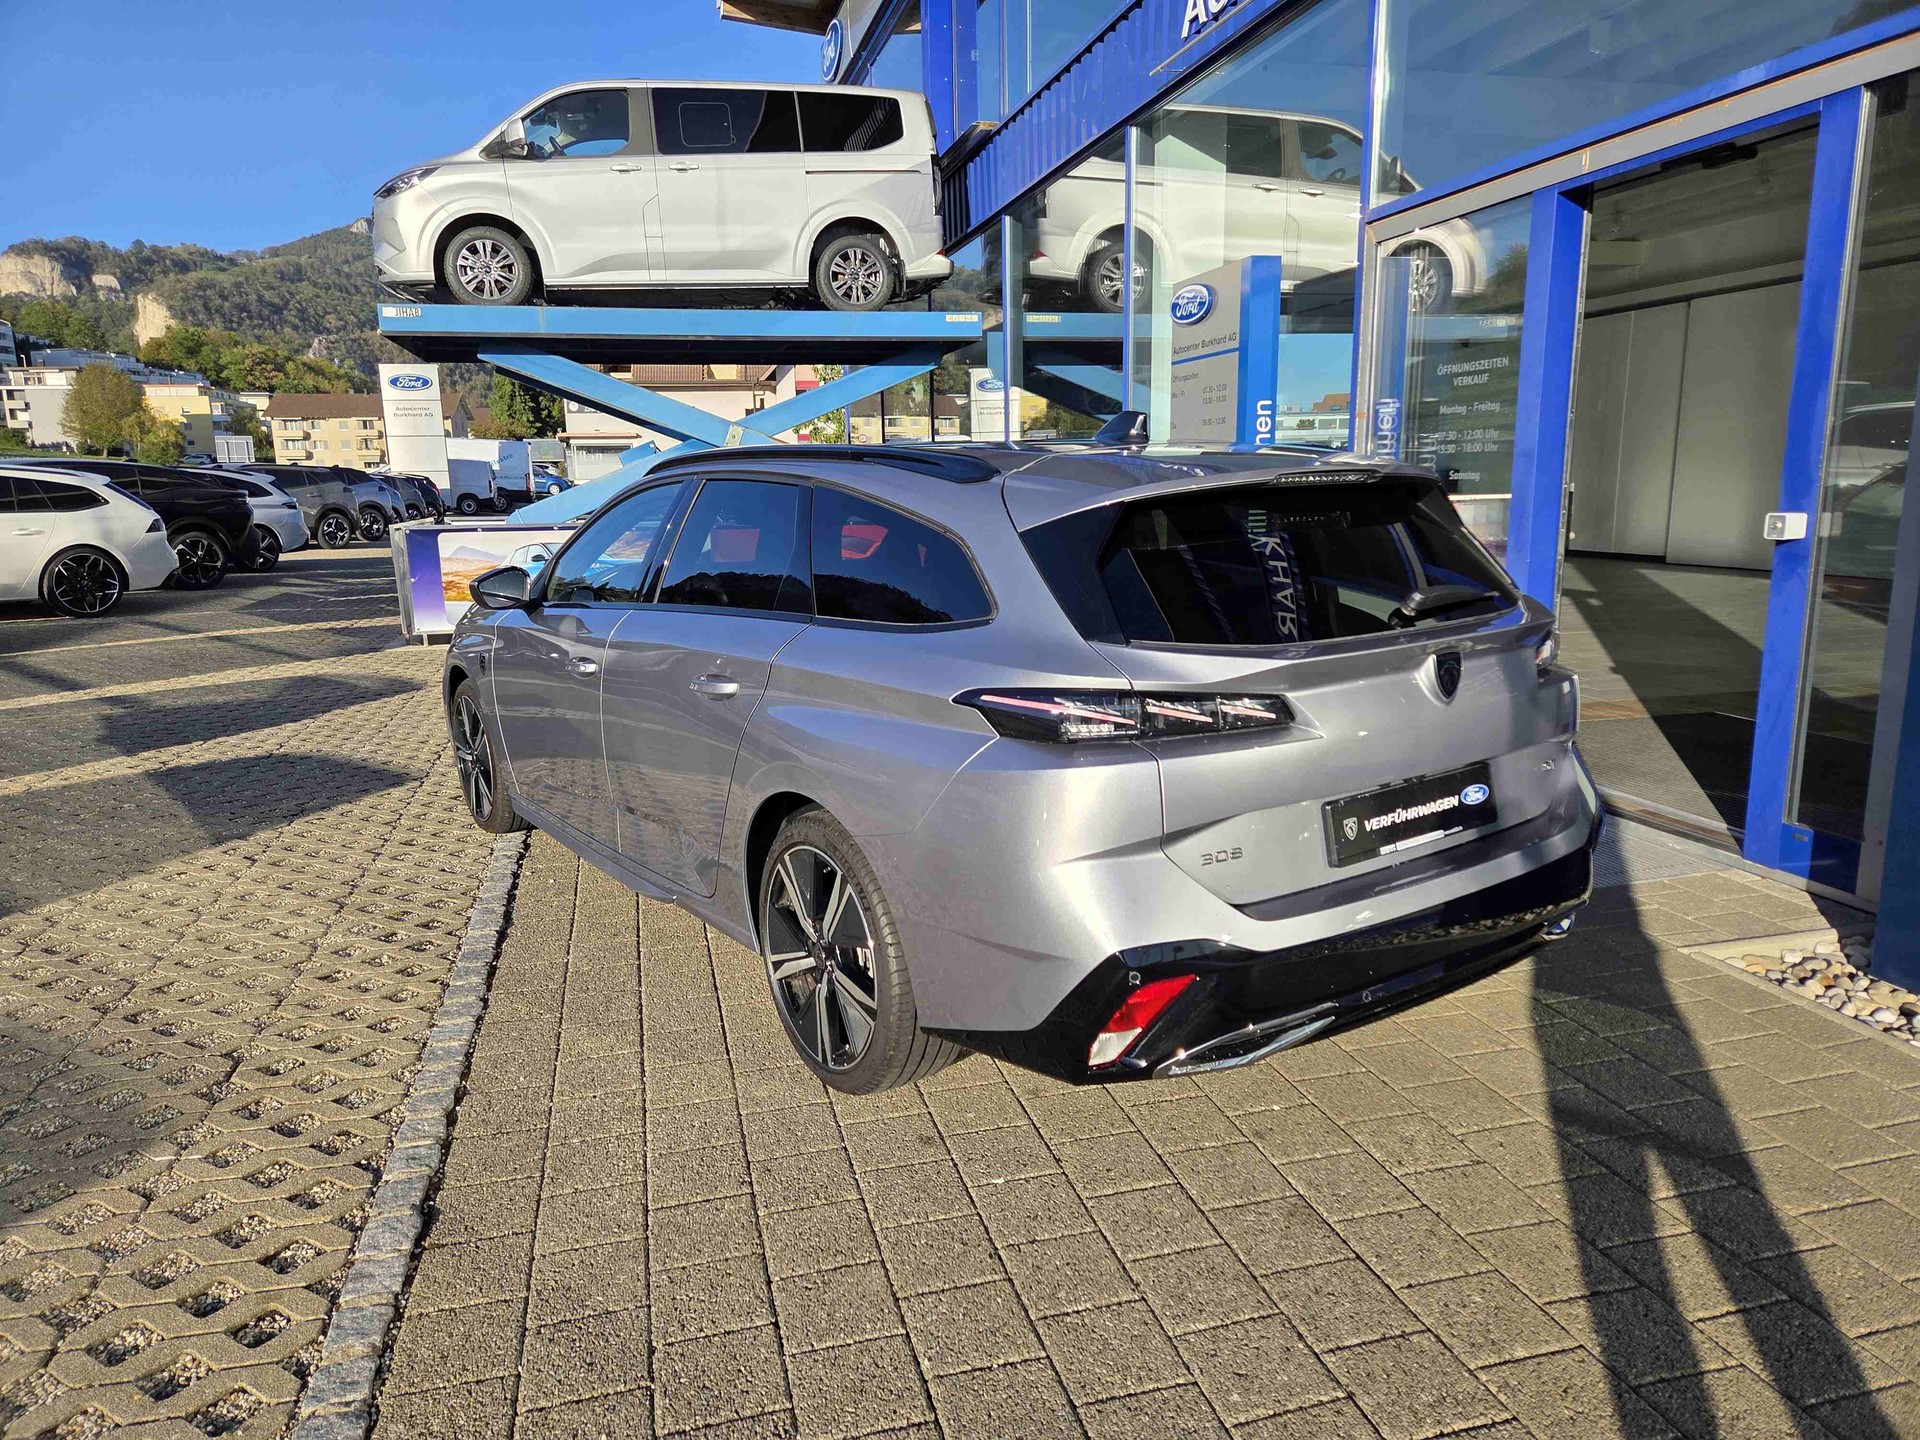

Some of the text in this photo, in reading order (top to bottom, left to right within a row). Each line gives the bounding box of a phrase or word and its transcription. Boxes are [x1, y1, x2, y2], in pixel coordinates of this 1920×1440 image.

[1173, 332, 1237, 355] Autocenter Burkhard AG
[1437, 356, 1509, 375] ÖFFNUNGSZEITEN
[1452, 373, 1490, 386] VERKAUF
[1439, 403, 1467, 415] Montag
[1473, 400, 1501, 412] Freitag
[1463, 429, 1484, 439] 12:00
[1485, 427, 1500, 438] Uhr
[1463, 442, 1483, 453] 18:00
[1484, 441, 1499, 452] Uhr
[1448, 470, 1480, 481] Samstag
[1364, 795, 1460, 832] VERFÜHRWAGEN
[1200, 847, 1243, 866] 308
